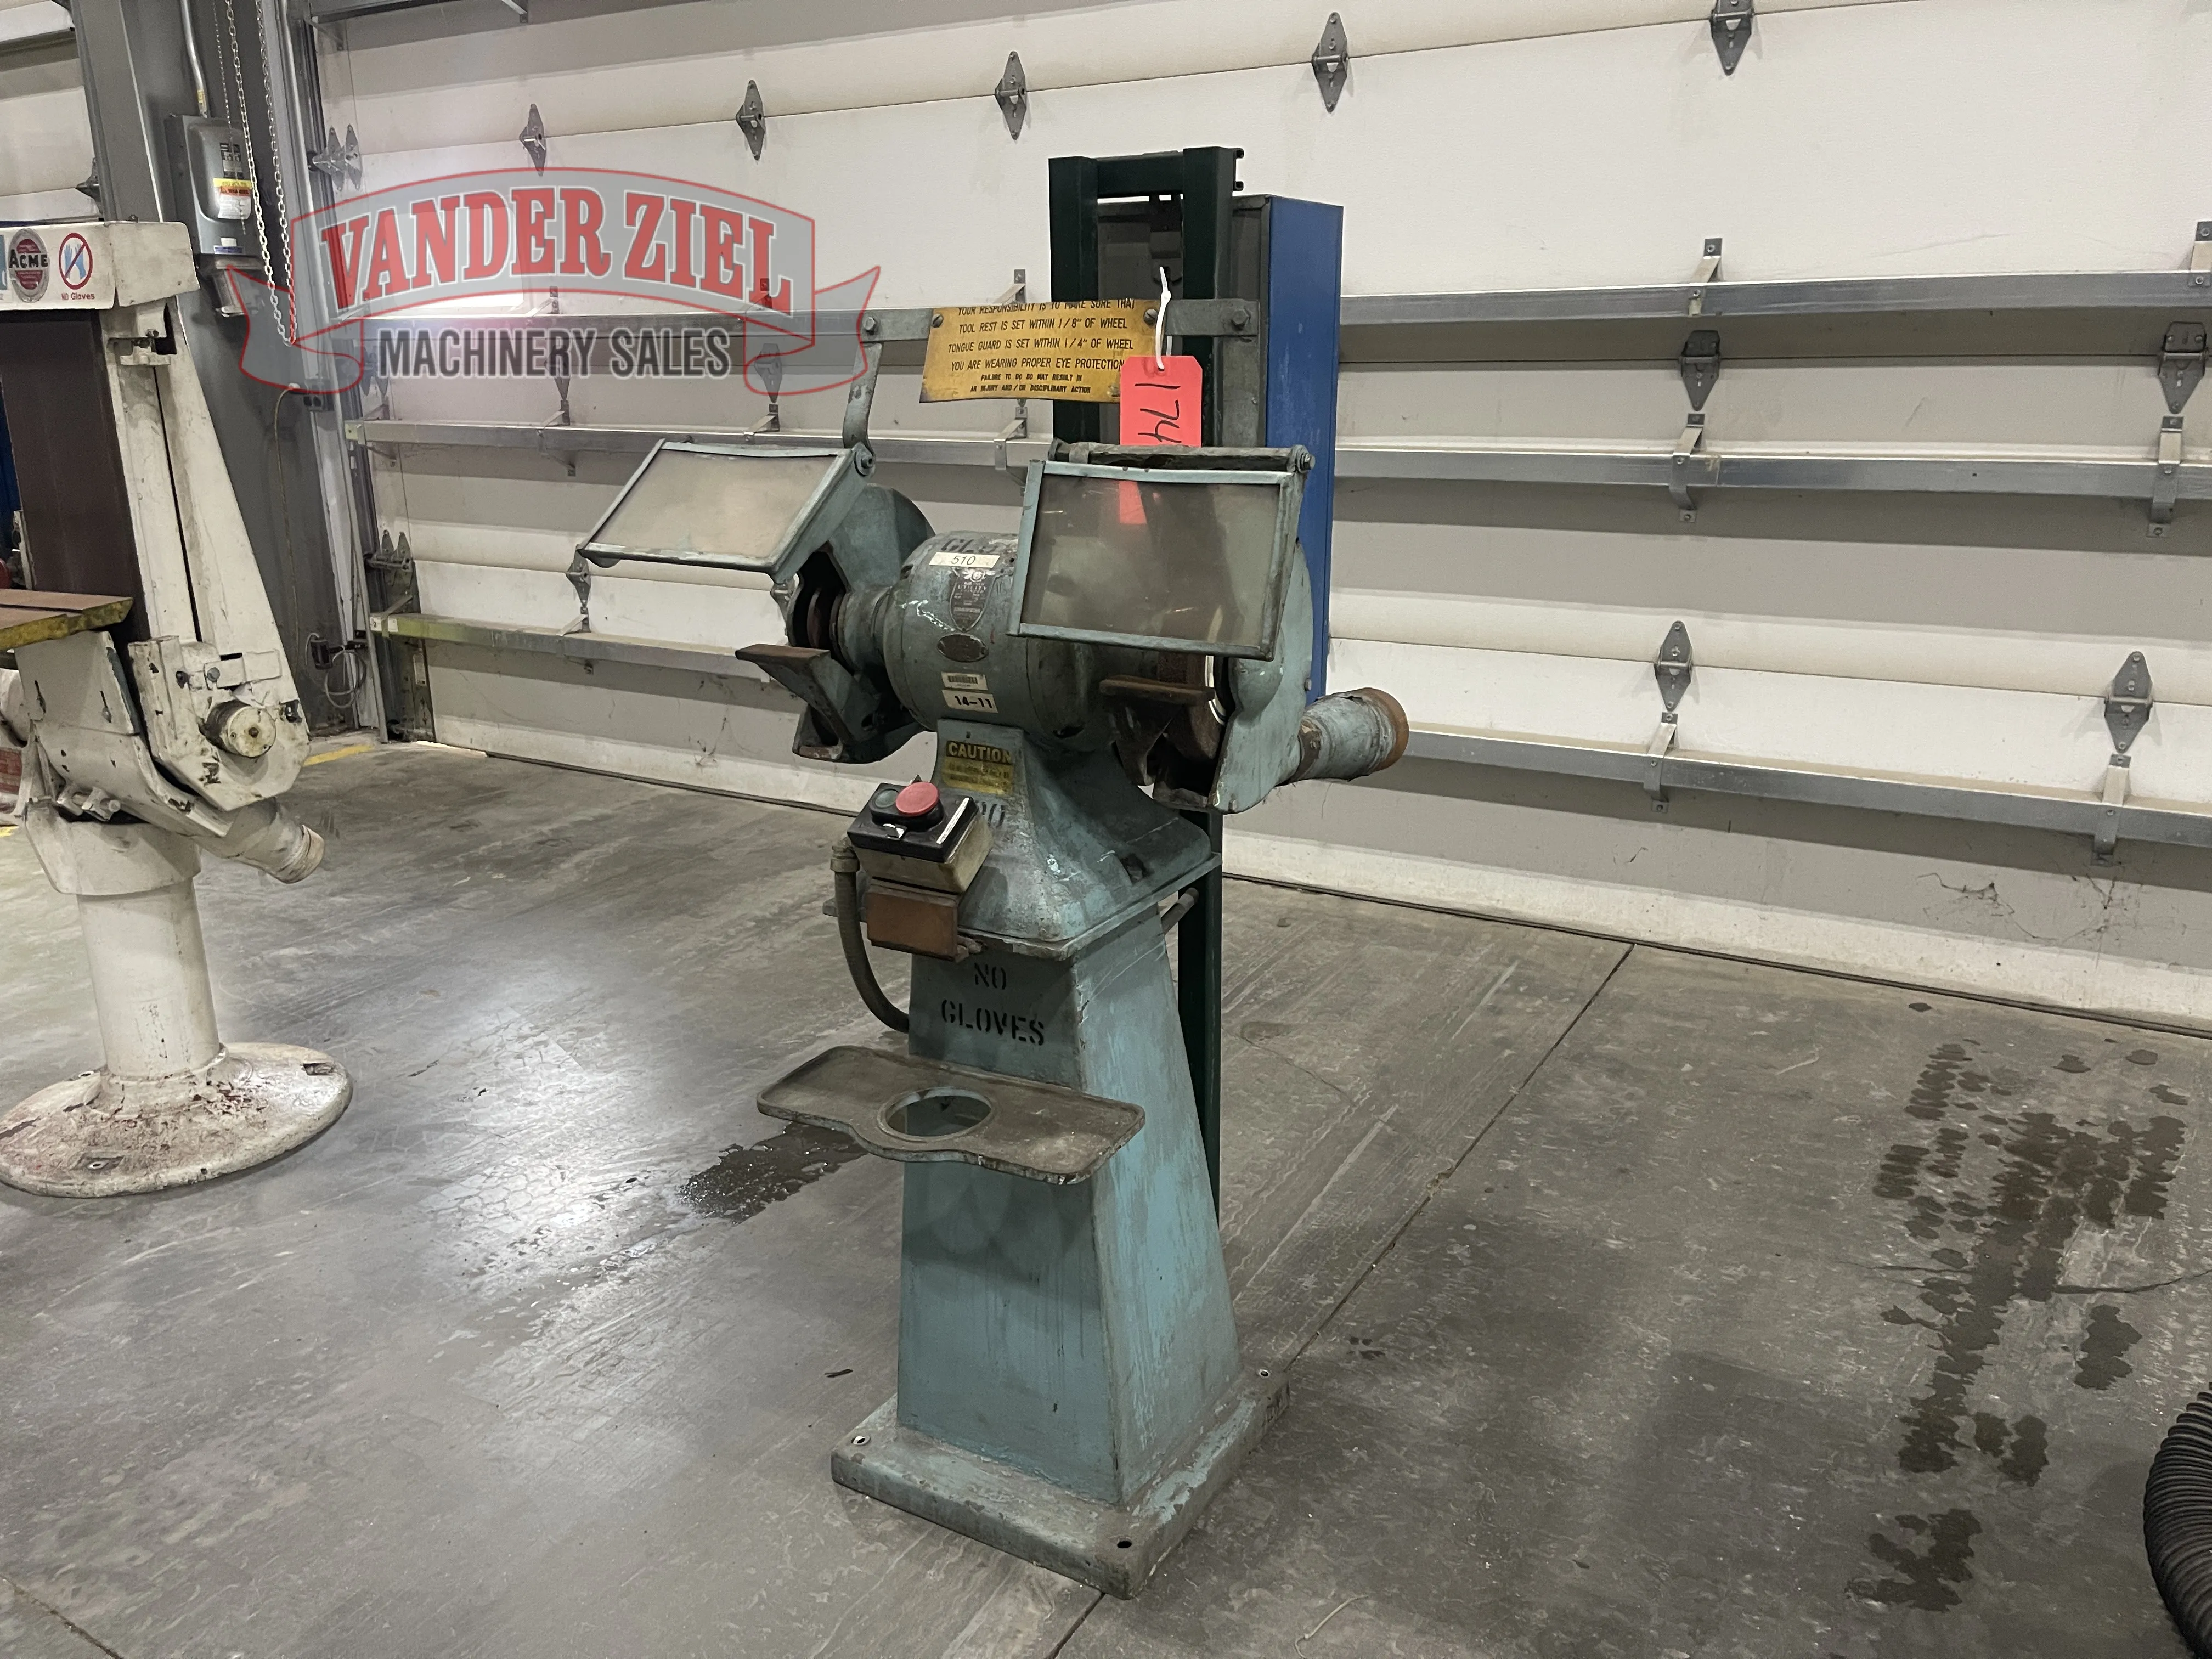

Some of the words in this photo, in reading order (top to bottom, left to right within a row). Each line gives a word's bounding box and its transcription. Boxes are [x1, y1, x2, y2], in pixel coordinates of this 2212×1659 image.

[9, 249, 48, 269] ACME
[958, 307, 977, 316] YOUR
[979, 303, 1035, 315] RESPONSIBILITY
[1039, 302, 1046, 311] IS
[1052, 302, 1060, 310] TO
[1064, 300, 1086, 309] MAKE
[1090, 300, 1111, 309] SURE
[1116, 299, 1135, 309] THAT
[959, 323, 975, 334] TOOL
[979, 321, 997, 332] REST
[1001, 321, 1008, 330] IS
[1011, 320, 1025, 330] SET
[1029, 318, 1054, 329] WITHIN
[1085, 318, 1096, 328] OF
[1100, 318, 1128, 329] WHEEL
[948, 342, 974, 353] TONGUE
[978, 340, 1001, 351] GUARD
[1005, 339, 1012, 349] IS
[1016, 338, 1030, 349] SET
[1034, 338, 1060, 348] WITHIN
[1091, 338, 1102, 349] OF
[1107, 338, 1134, 349] WHEEL
[951, 361, 964, 371] YOU
[967, 359, 981, 370] ARE
[985, 358, 1018, 369] WEARING
[1021, 357, 1051, 368] PROPER
[1056, 358, 1072, 369] EYE
[1075, 358, 1125, 372] PROTECTION
[1052, 374, 1073, 382] RESULT
[1030, 385, 1067, 393] DISCIPLINARY
[1071, 386, 1091, 394] ACTION
[1135, 383, 1182, 443] 174
[951, 555, 976, 565] 510
[955, 696, 992, 708] 14-11
[948, 742, 1013, 764] CAUTION
[974, 962, 1007, 990] NO
[941, 999, 1045, 1046] GLOVES
